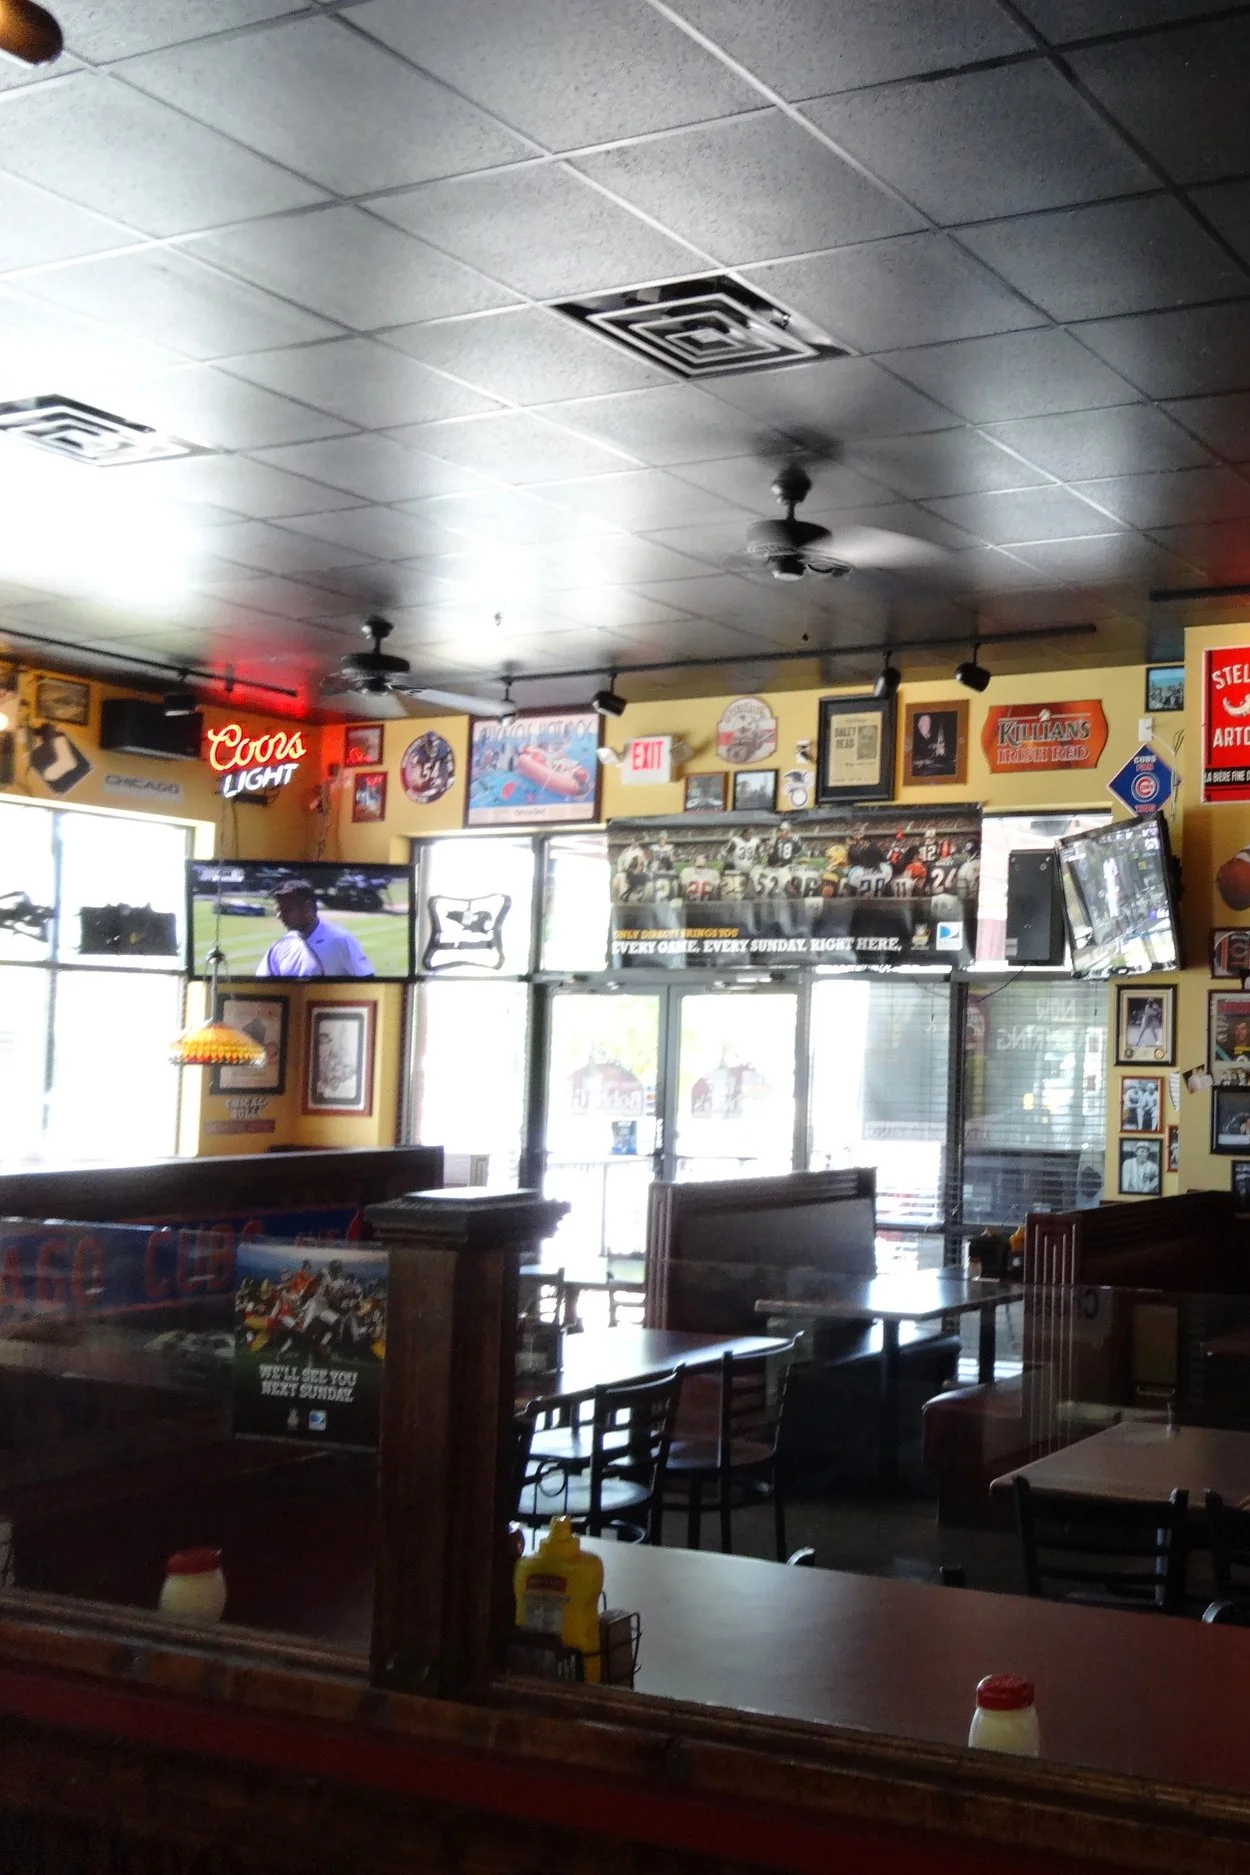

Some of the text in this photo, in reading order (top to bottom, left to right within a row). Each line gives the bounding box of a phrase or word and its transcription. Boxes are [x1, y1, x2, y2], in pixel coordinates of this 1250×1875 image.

[207, 723, 307, 771] Coors
[631, 740, 665, 772] EXIT
[997, 744, 1091, 765] IRISH RED
[222, 762, 300, 799] LIGHT
[777, 842, 794, 860] 18
[611, 940, 660, 955] EVERY
[703, 938, 750, 953] EVERY
[809, 937, 855, 952] RIGHT
[145, 1218, 266, 1297] CUB
[259, 1363, 359, 1387] WE'LL SEE YOU
[261, 1380, 299, 1399] NEXT
